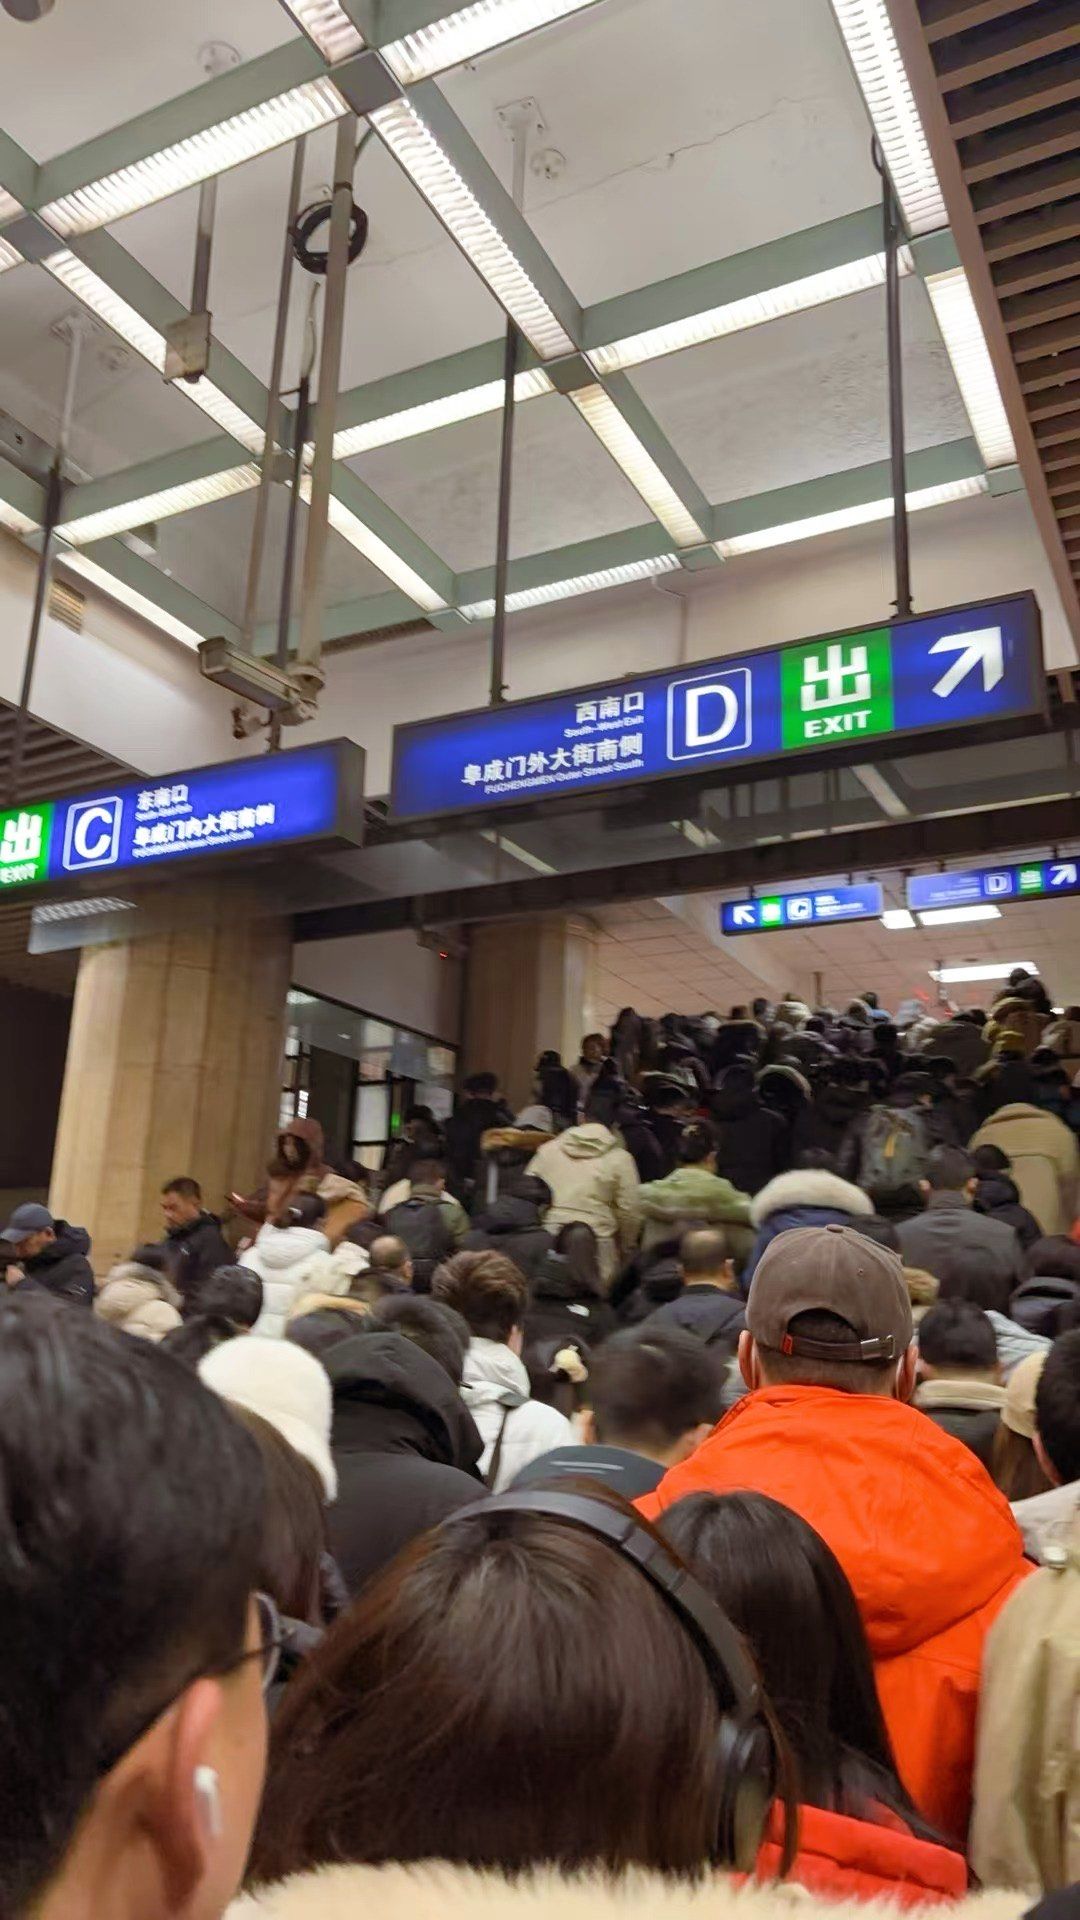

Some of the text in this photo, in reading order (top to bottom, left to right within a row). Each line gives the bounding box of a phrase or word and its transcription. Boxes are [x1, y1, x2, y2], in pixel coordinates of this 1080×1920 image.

[801, 645, 871, 711] 出
[575, 691, 645, 723] 西南口
[686, 685, 738, 747] D
[804, 710, 872, 738] EXIT
[0, 812, 43, 863] 出
[75, 807, 113, 859] C
[988, 876, 1007, 892] D
